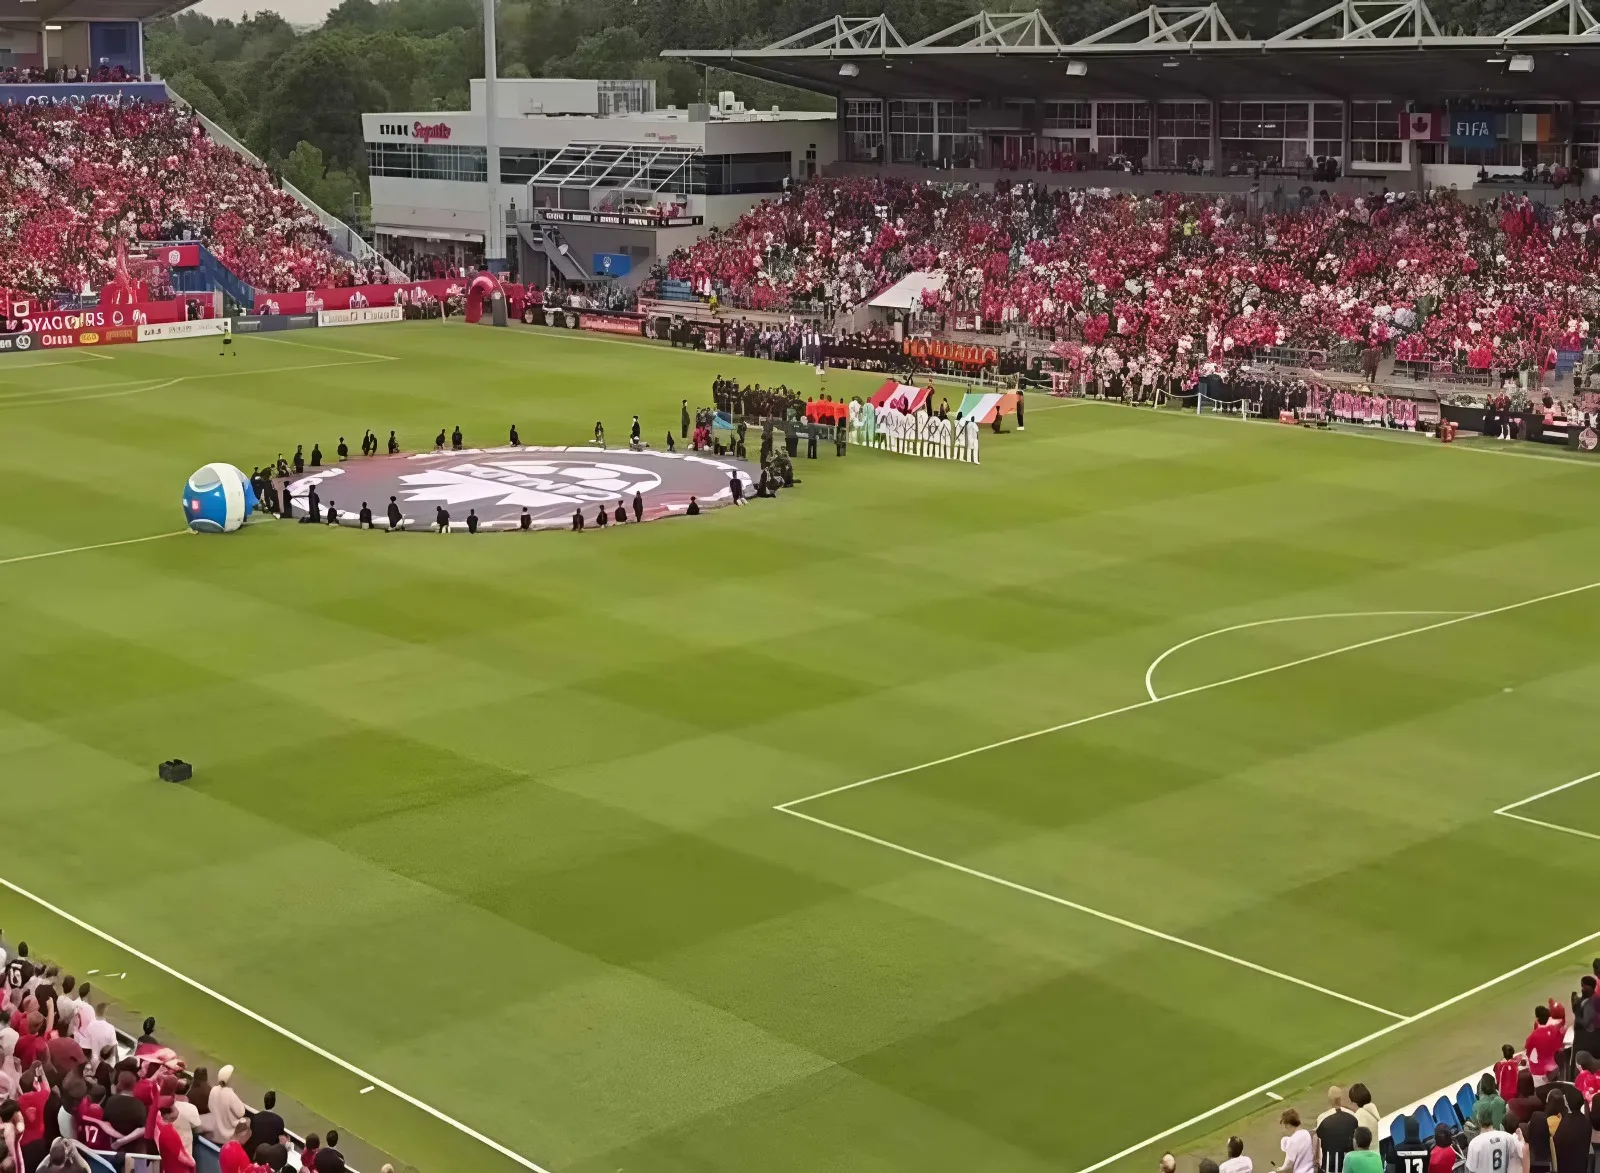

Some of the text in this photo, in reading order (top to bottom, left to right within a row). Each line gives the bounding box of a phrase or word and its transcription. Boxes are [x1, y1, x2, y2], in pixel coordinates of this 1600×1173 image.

[1456, 121, 1489, 136] FIFA
[85, 1125, 98, 1143] 17
[1493, 1149, 1502, 1170] 8
